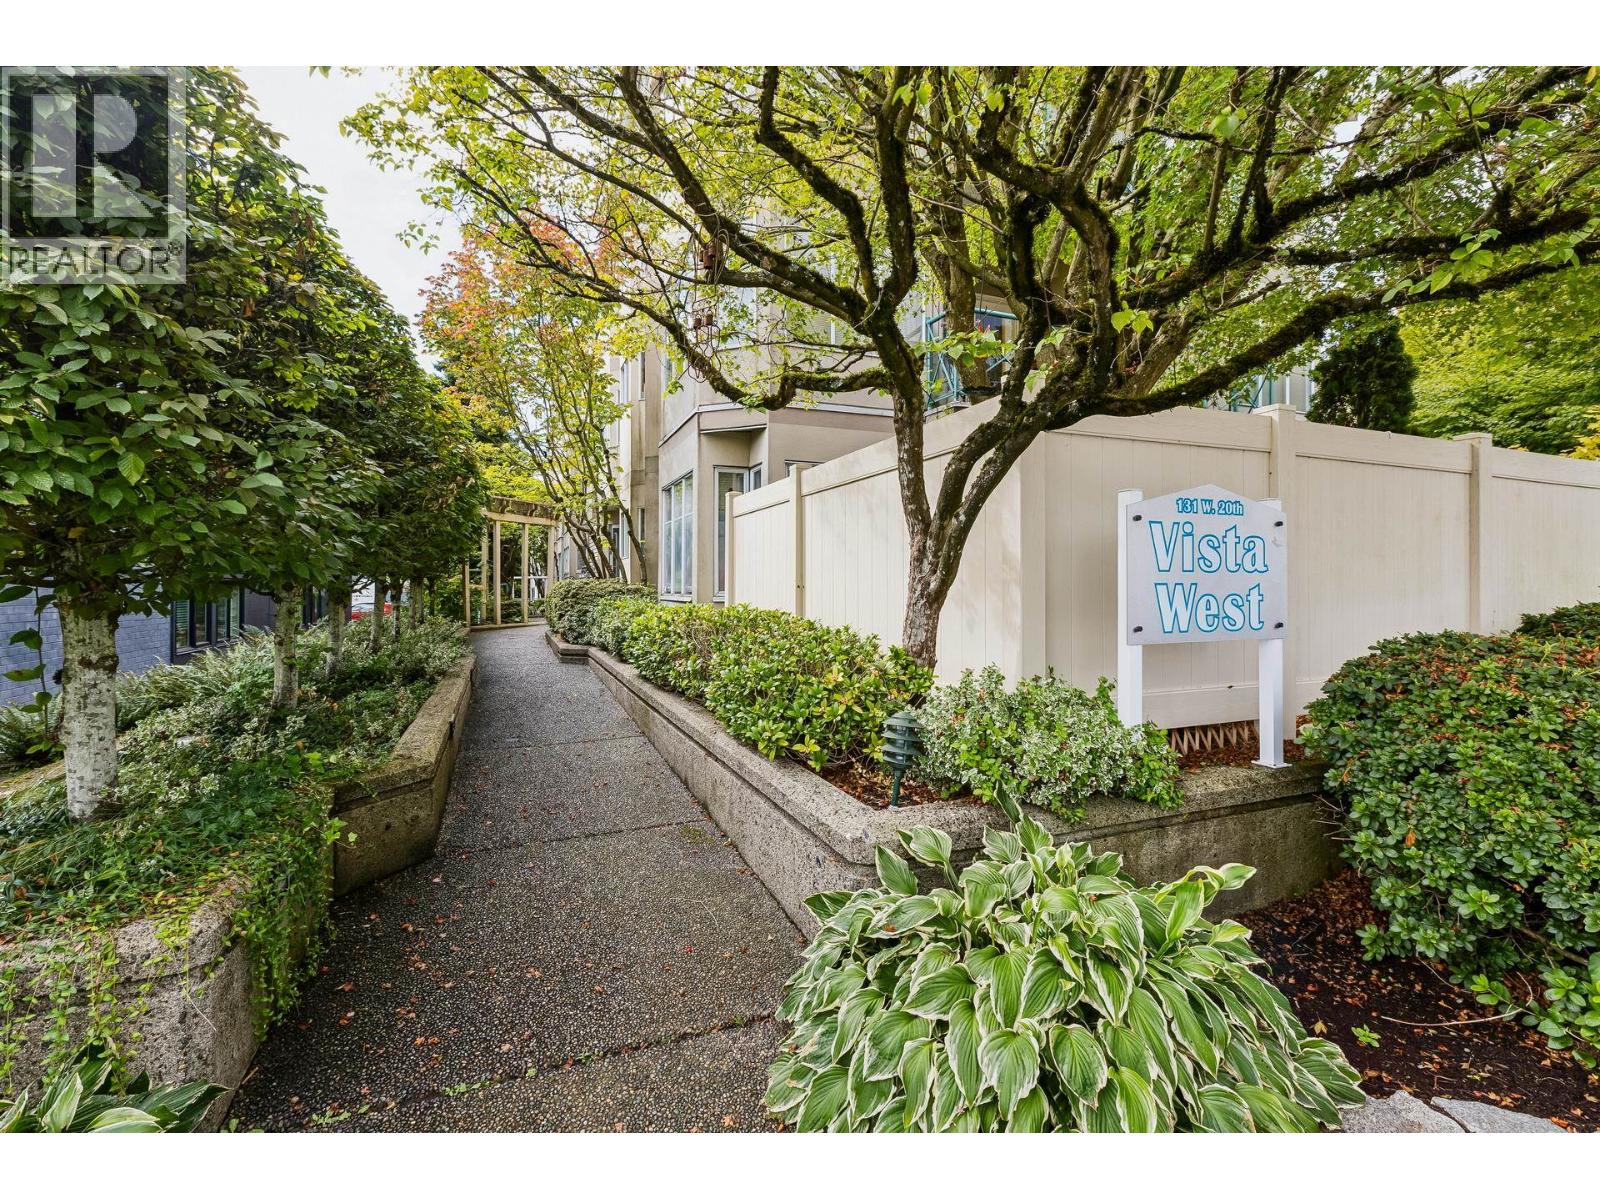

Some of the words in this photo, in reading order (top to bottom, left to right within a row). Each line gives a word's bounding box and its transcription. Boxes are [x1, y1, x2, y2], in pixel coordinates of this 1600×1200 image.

[1176, 498, 1198, 514] 131
[1200, 499, 1216, 514] W.
[1217, 500, 1244, 516] 20th
[1149, 521, 1269, 574] Vista
[1154, 583, 1265, 633] West
